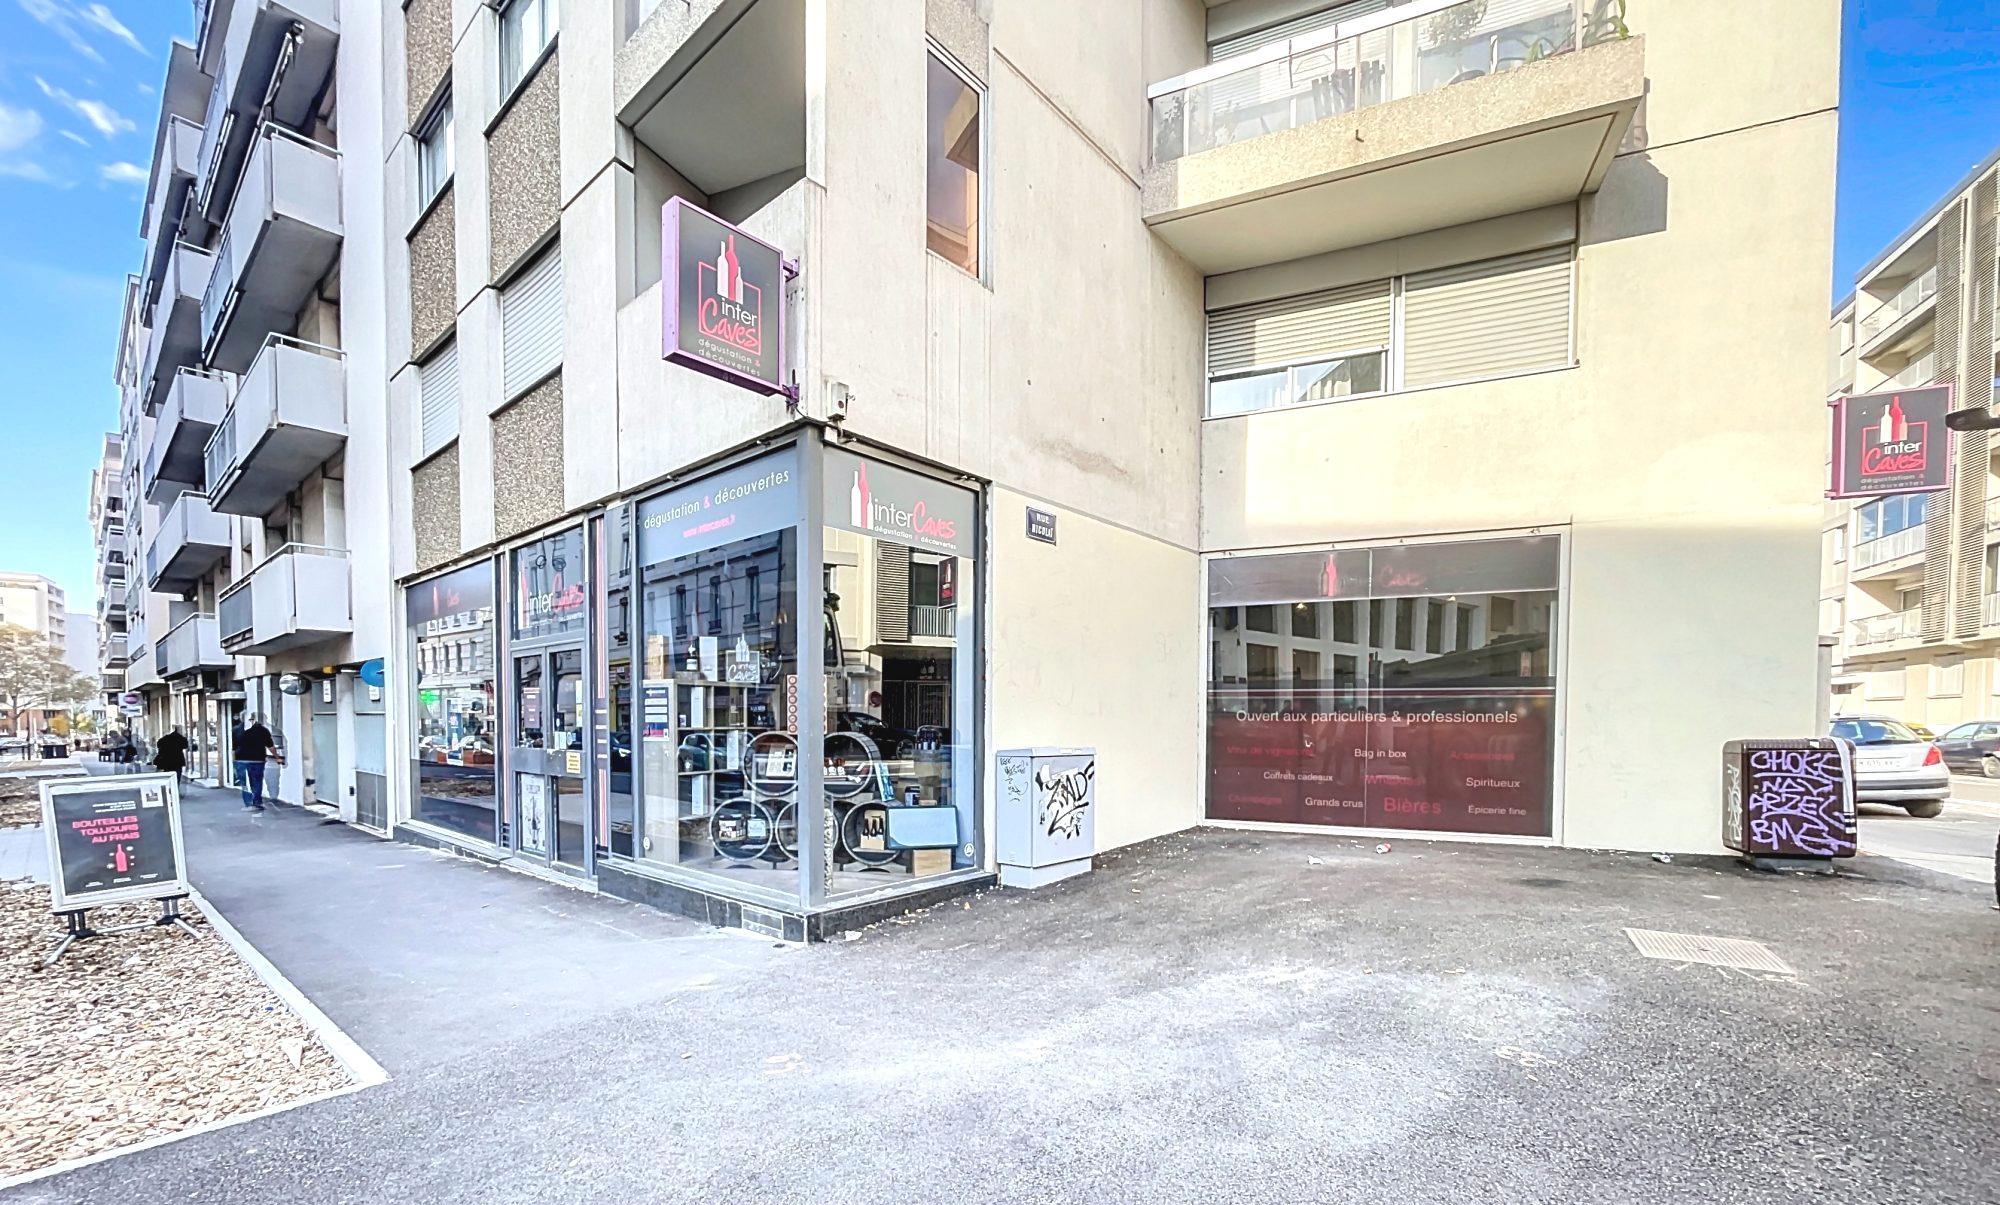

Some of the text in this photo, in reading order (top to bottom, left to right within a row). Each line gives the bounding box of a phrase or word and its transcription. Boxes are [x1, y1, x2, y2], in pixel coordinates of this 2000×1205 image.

[721, 297, 757, 326] inter
[701, 297, 759, 347] Caves
[698, 338, 752, 364] dégustation
[698, 348, 761, 377] découvertes
[1884, 441, 1922, 455] inter
[1864, 447, 1925, 473] Caves
[644, 470, 789, 529] dégustation & découvertes
[1236, 710, 1518, 725] Ouvert aux particuliers & professionnels
[1354, 748, 1407, 760] Bag in box
[1263, 771, 1333, 782] Coffrets cadeaux
[1466, 777, 1521, 788] Spiritueux
[1305, 797, 1364, 809] Grands crus
[1383, 796, 1442, 815] Bières
[1508, 806, 1527, 816] fine
[72, 815, 138, 829] BOUTEILLES
[80, 823, 139, 836] TOUJOURS
[92, 831, 140, 843] AU FRAIS
